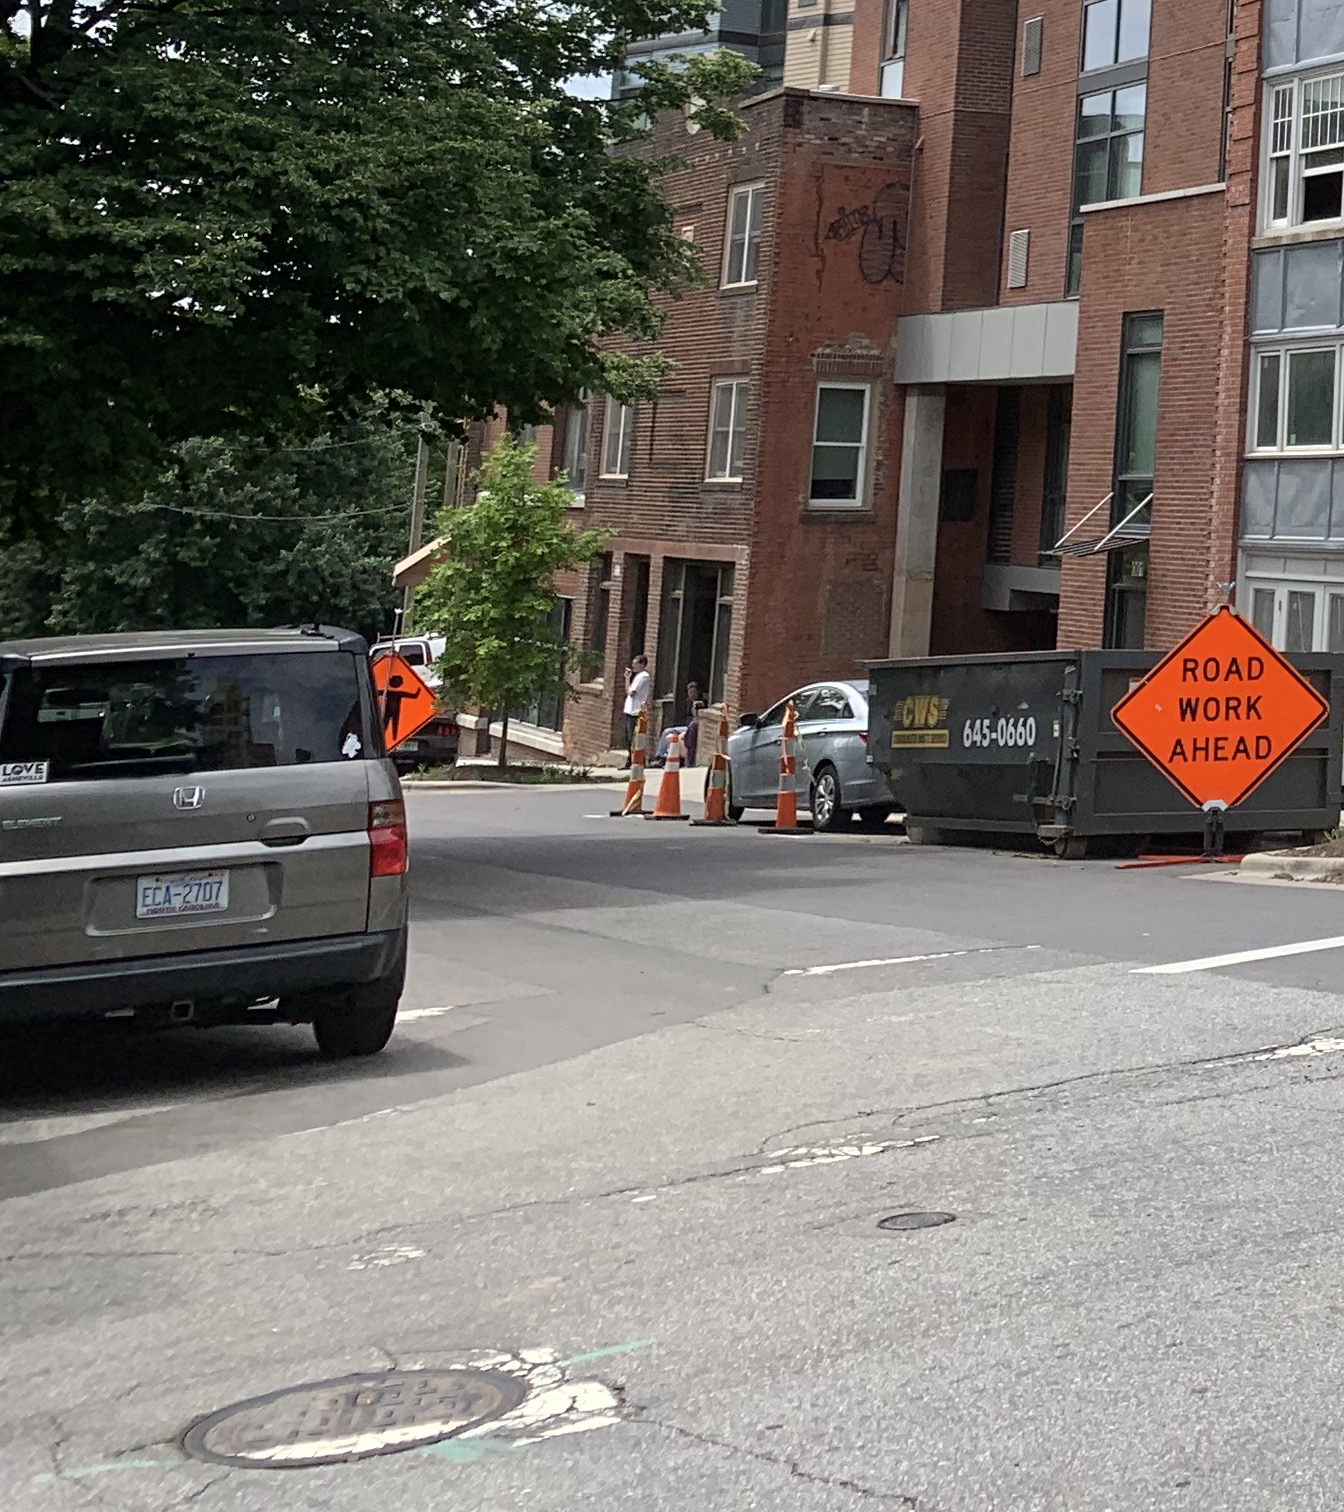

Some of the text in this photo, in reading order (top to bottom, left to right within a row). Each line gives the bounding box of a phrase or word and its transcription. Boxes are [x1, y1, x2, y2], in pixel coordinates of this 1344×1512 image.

[1182, 656, 1265, 683] ROAD
[902, 695, 941, 728] CWS
[1178, 695, 1263, 722] WORK
[962, 716, 1036, 748] 645-0660
[1168, 735, 1272, 763] AHEAD
[2, 763, 45, 776] LOVE
[142, 881, 223, 907] ECA-2707
